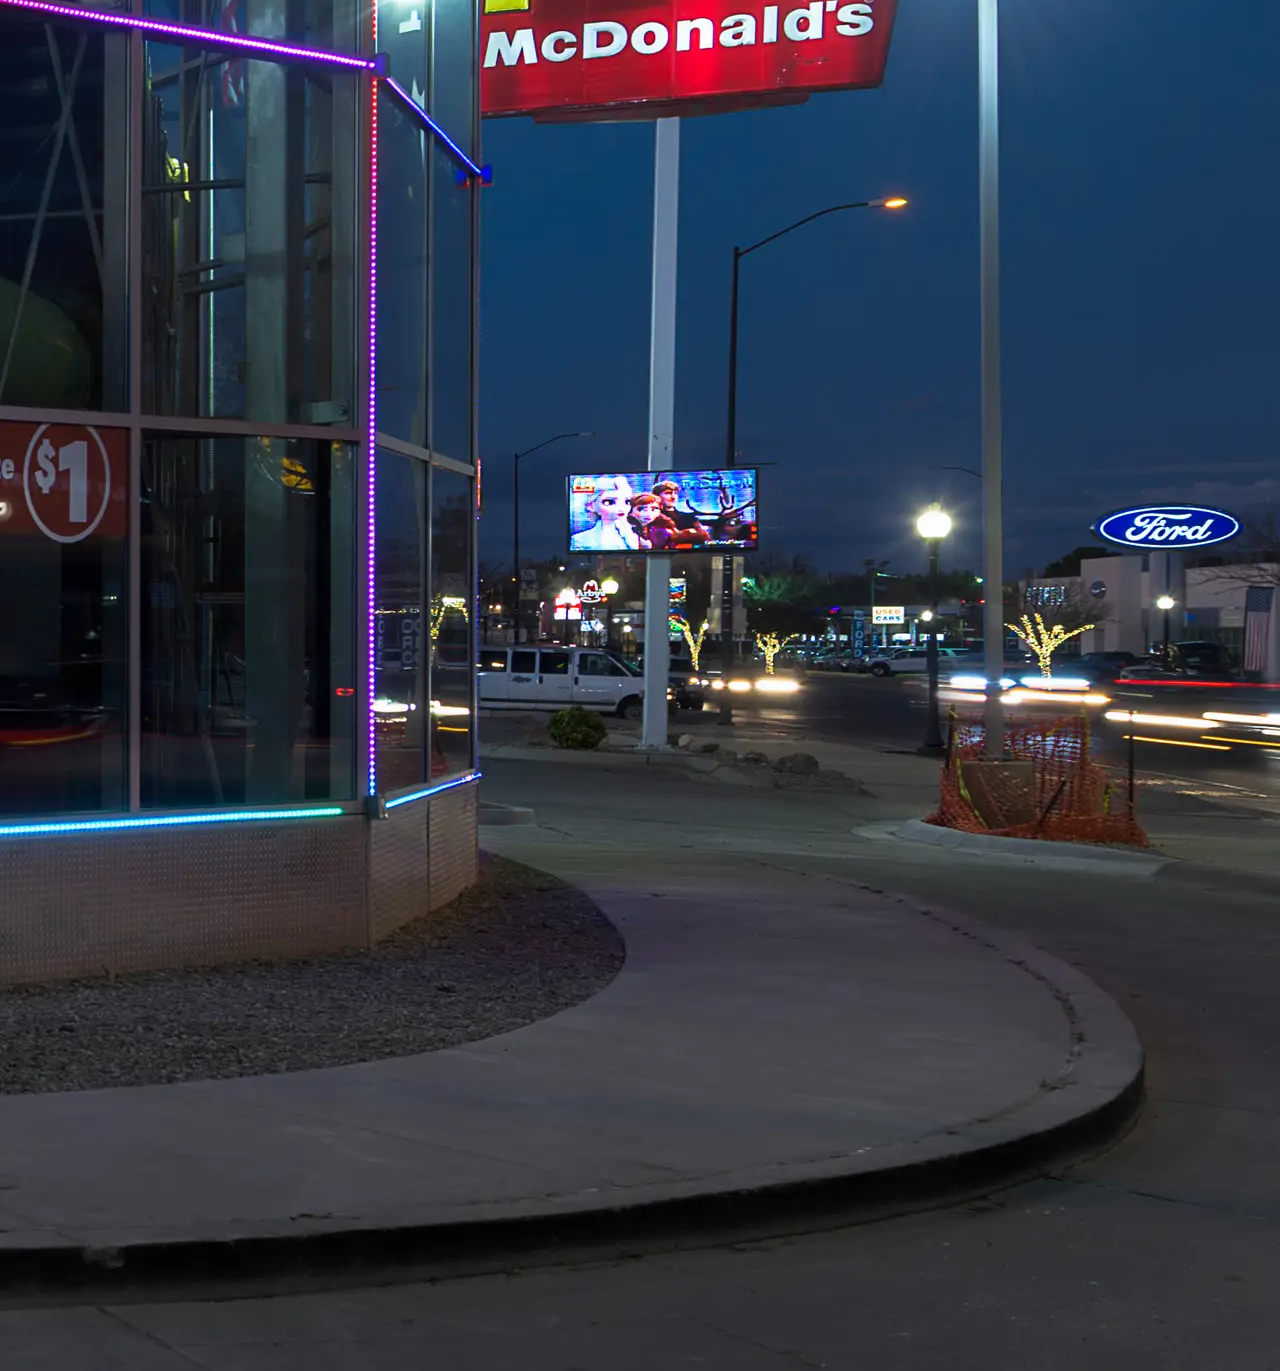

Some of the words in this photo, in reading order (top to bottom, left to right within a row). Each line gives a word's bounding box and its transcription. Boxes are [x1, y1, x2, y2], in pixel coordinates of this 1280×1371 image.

[483, 0, 874, 68] McDonald's
[35, 439, 88, 522] $1
[1125, 513, 1215, 541] Ford
[855, 621, 864, 657] FORD
